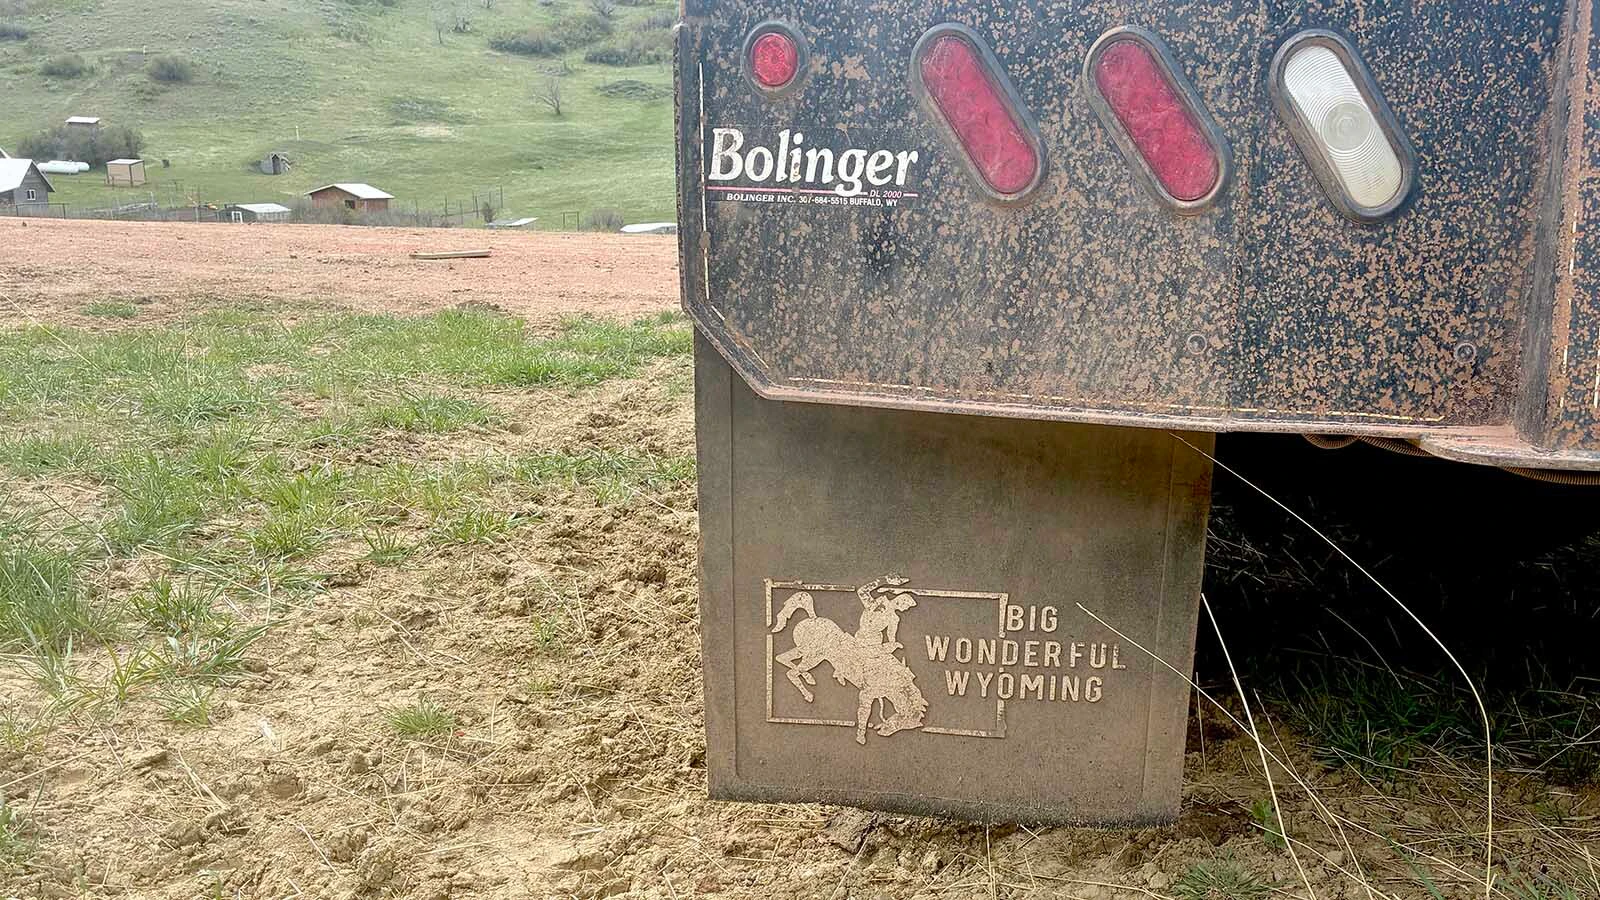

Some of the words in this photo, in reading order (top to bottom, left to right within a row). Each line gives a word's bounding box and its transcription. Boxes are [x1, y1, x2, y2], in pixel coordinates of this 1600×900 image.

[708, 127, 919, 197] Bolinger
[726, 193, 775, 203] BOLINGER
[777, 194, 796, 204] INC.
[798, 196, 848, 206] 307-684-5515
[849, 198, 884, 208] BUFFALO,
[886, 200, 898, 208] WY
[869, 189, 882, 198] DL
[882, 190, 902, 199] 2000
[1006, 604, 1059, 633] BIG
[924, 635, 1128, 670] WONDERFUL
[944, 670, 1103, 703] WYOMING
